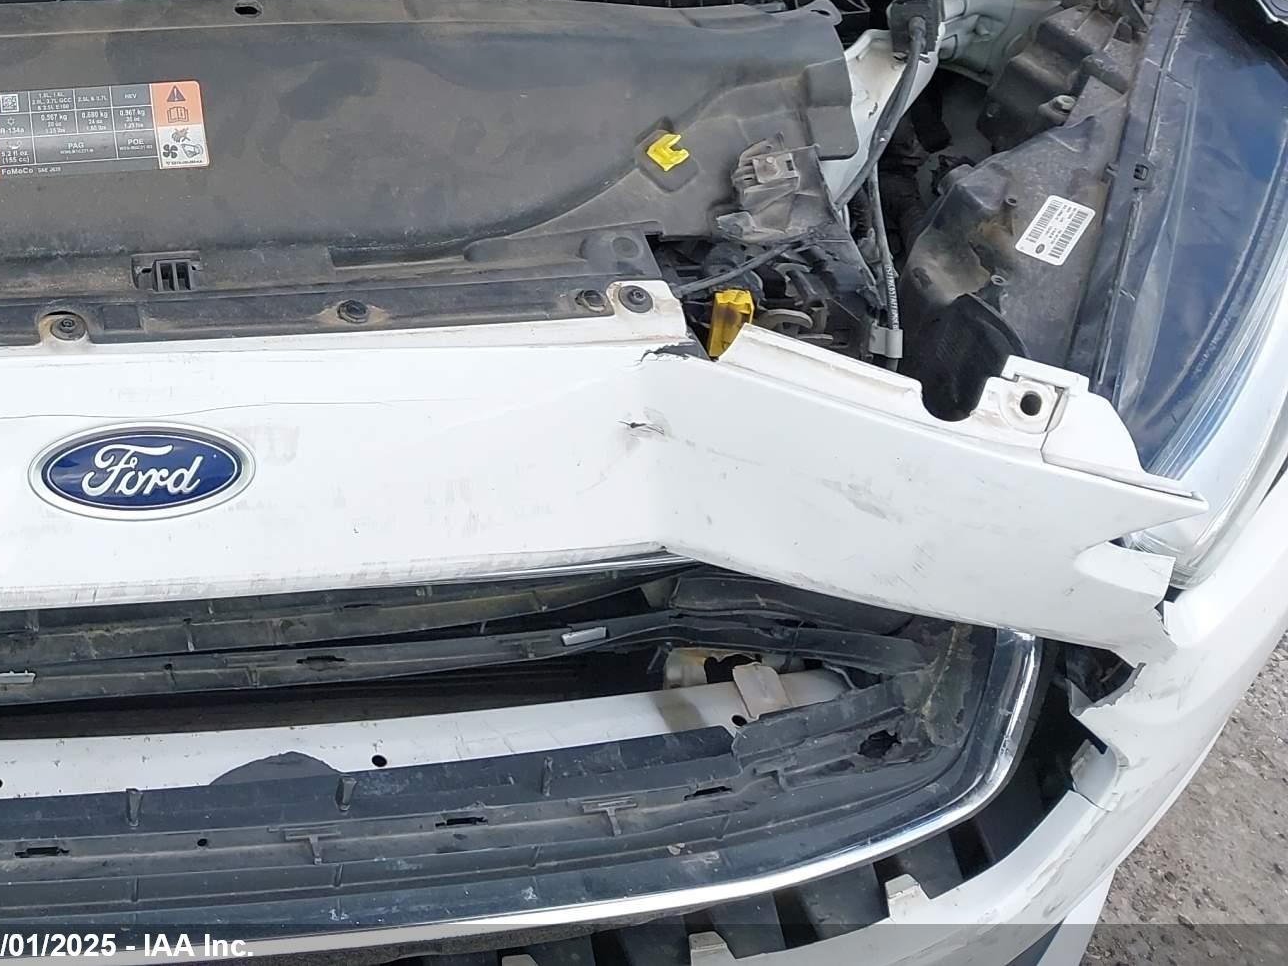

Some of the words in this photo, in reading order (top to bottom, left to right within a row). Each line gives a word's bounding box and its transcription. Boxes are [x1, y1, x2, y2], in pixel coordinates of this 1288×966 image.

[68, 141, 85, 149] PAG
[1, 167, 34, 175] FoMoCo
[82, 444, 204, 497] Ford
